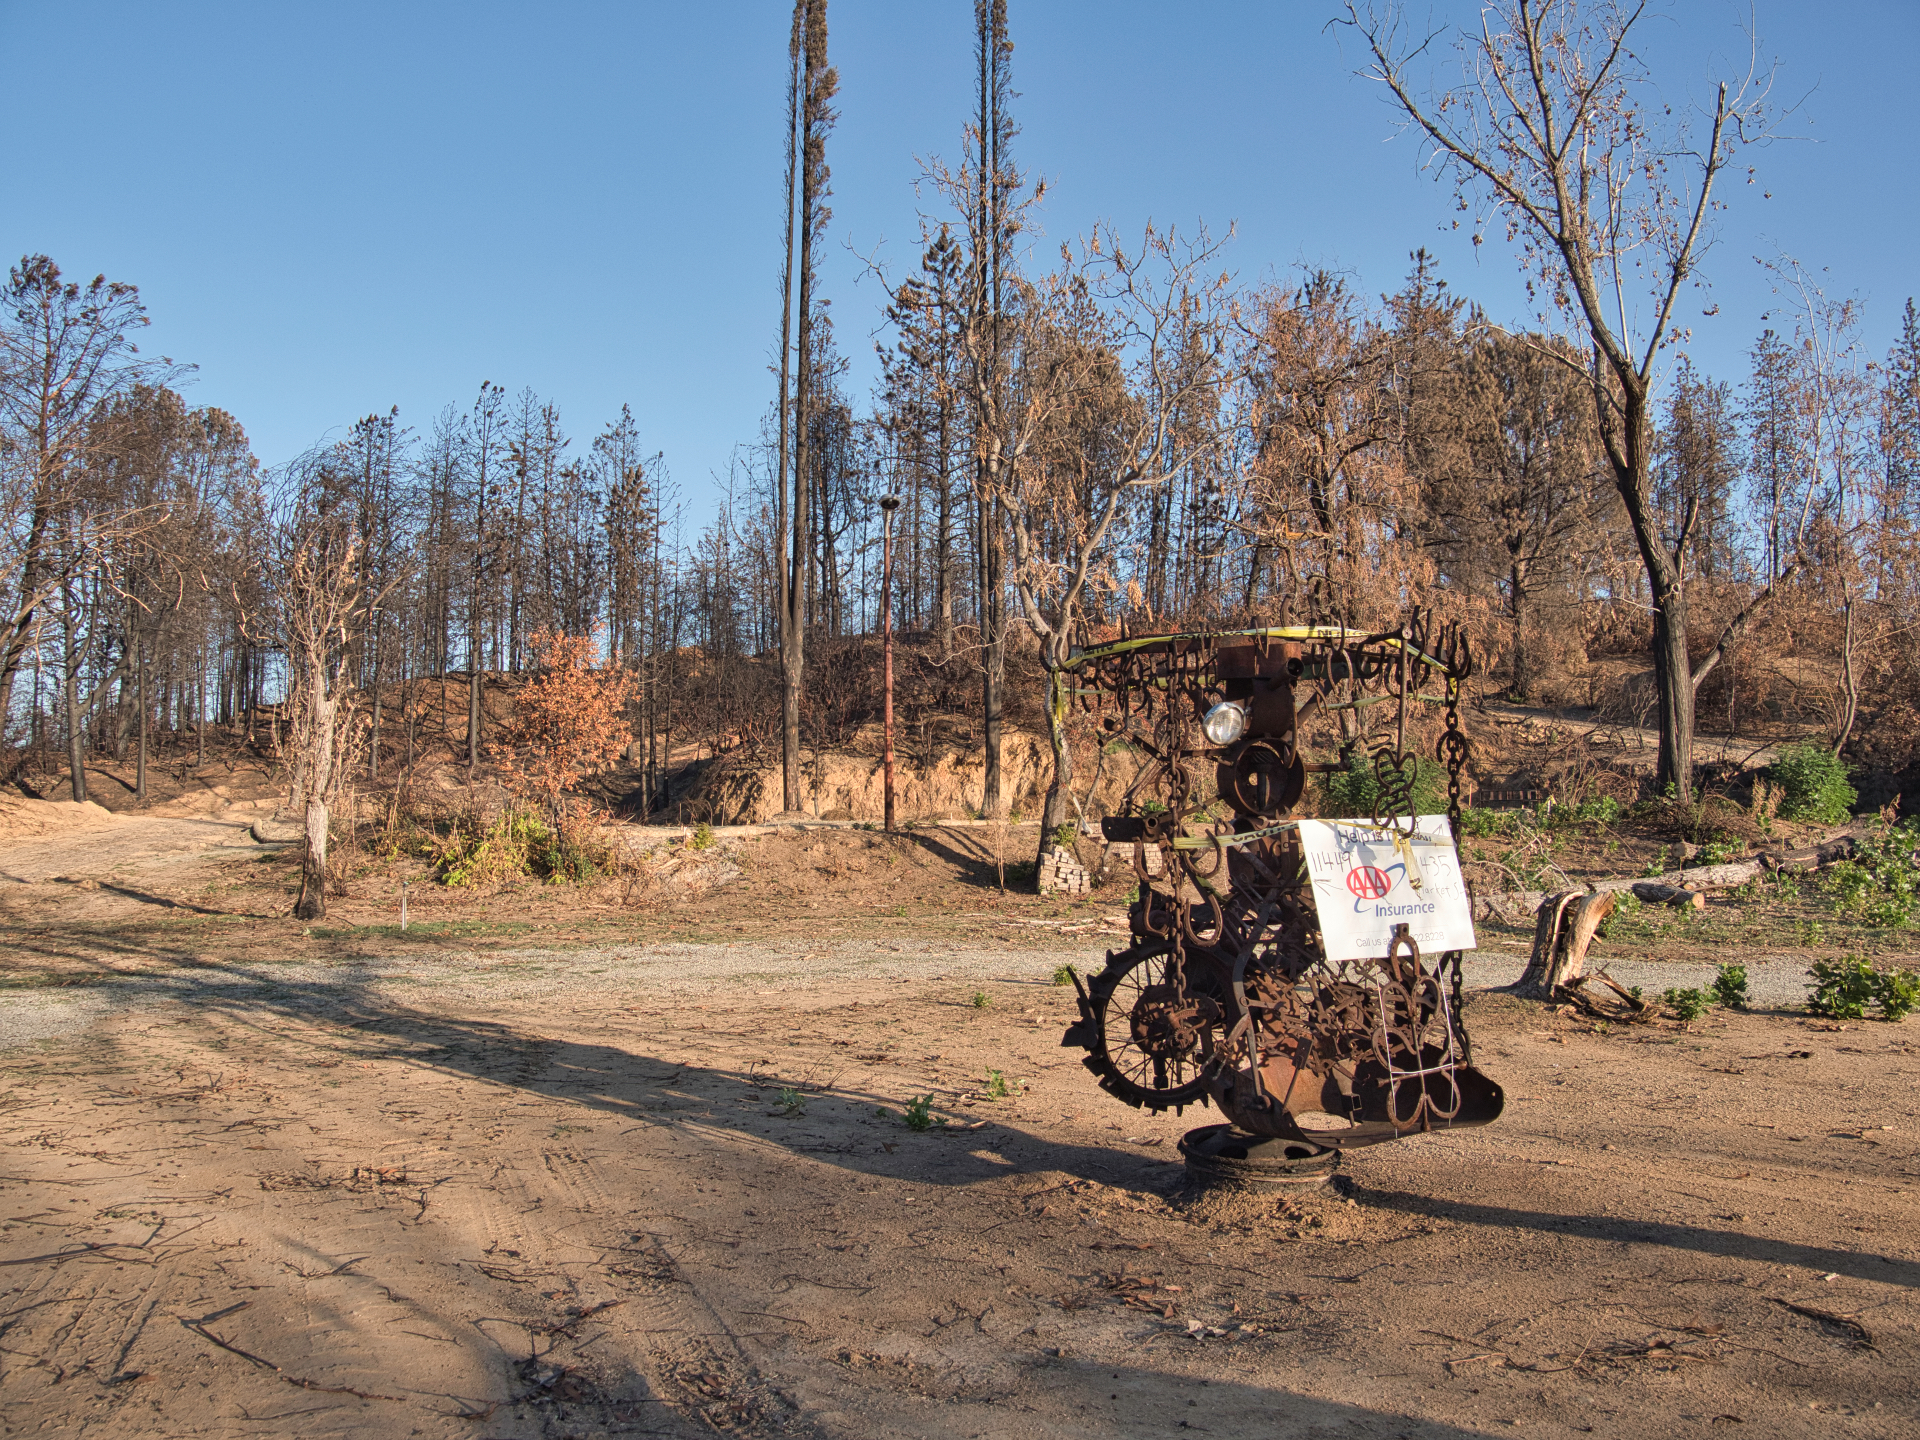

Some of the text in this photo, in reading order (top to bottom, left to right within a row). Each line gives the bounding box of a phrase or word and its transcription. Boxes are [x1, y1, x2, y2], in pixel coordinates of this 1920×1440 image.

[1337, 829, 1370, 846] Help
[1372, 829, 1384, 842] is
[1310, 850, 1354, 873] 11449
[1353, 867, 1388, 898] AAA
[1375, 902, 1435, 917] Insurance
[1355, 937, 1371, 947] Call
